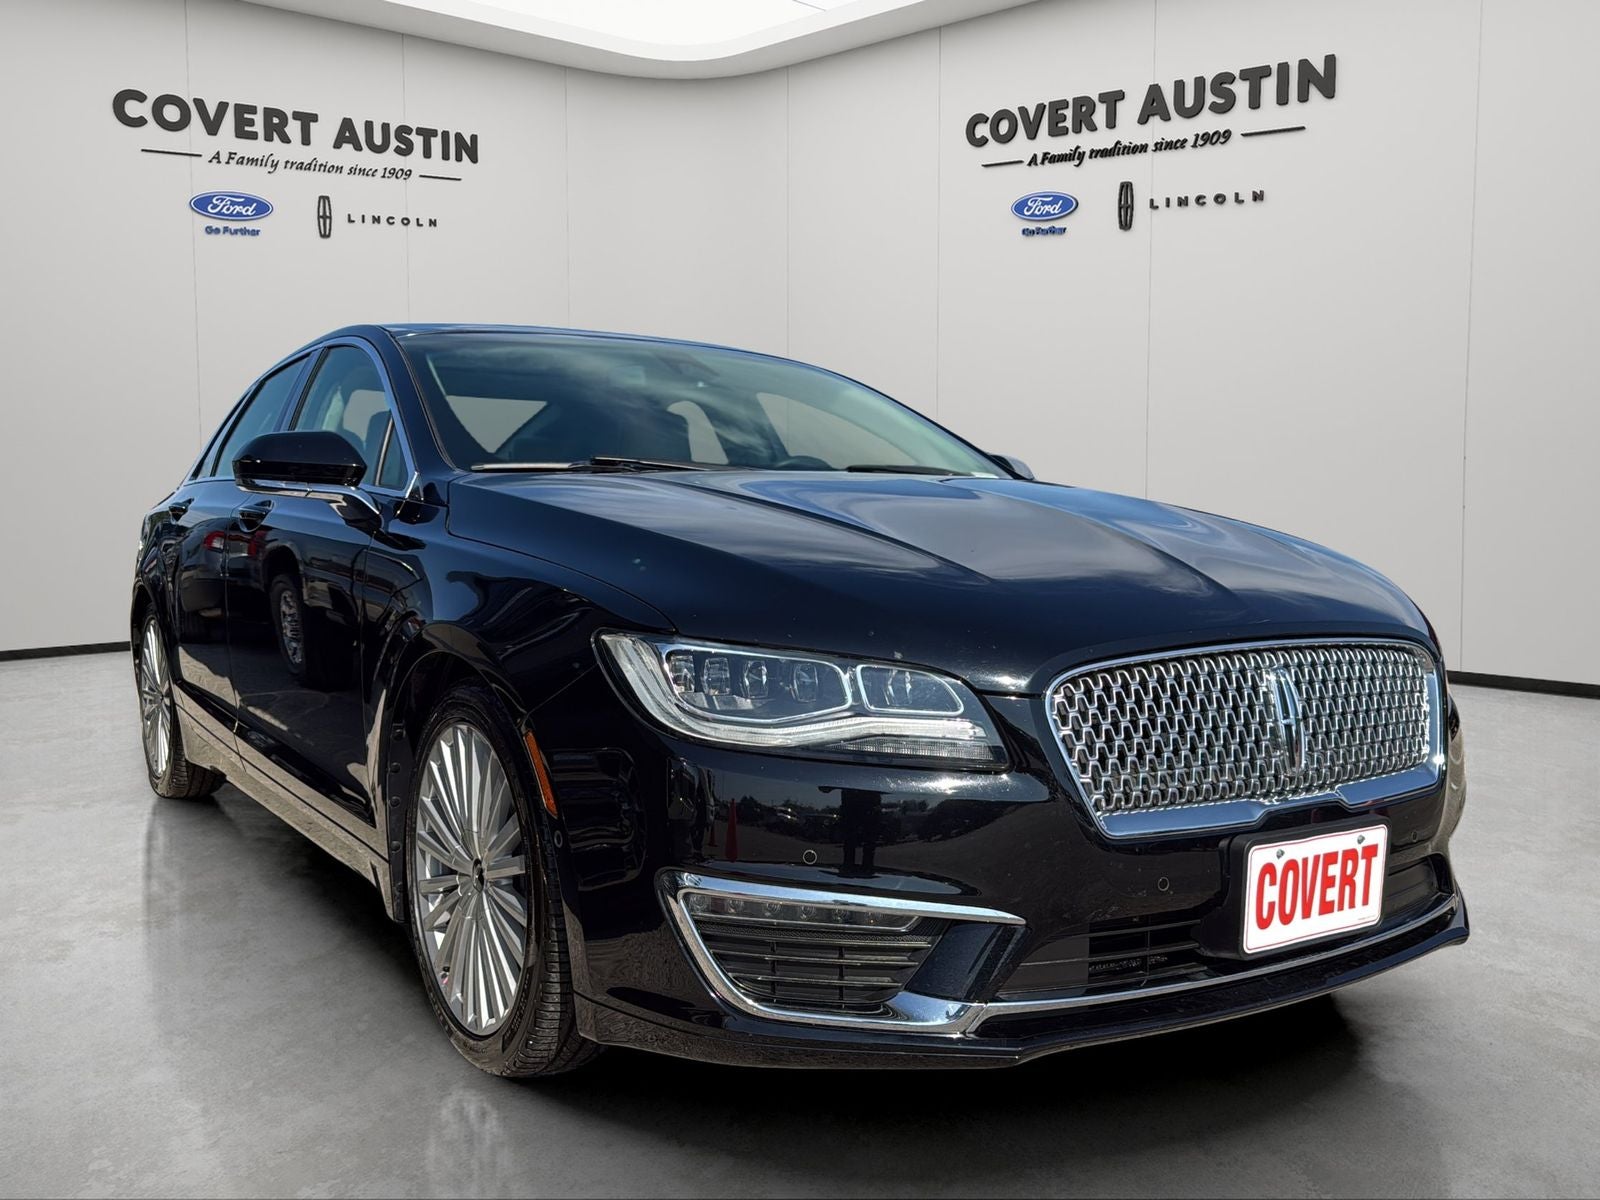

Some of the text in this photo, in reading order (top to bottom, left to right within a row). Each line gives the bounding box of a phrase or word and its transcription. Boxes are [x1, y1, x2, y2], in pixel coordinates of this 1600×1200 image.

[965, 53, 1337, 149] COVERT AUSTIN
[112, 88, 479, 165] COVERT AUSTIN
[1026, 128, 1233, 168] A Family tradition since 1909
[207, 150, 413, 181] A Family tradition since 1909
[207, 195, 257, 216] Ford
[1023, 196, 1063, 216] Ford
[1149, 189, 1265, 211] LINCOLN
[347, 213, 438, 228] LINCOLN
[1255, 843, 1379, 930] COVERT
